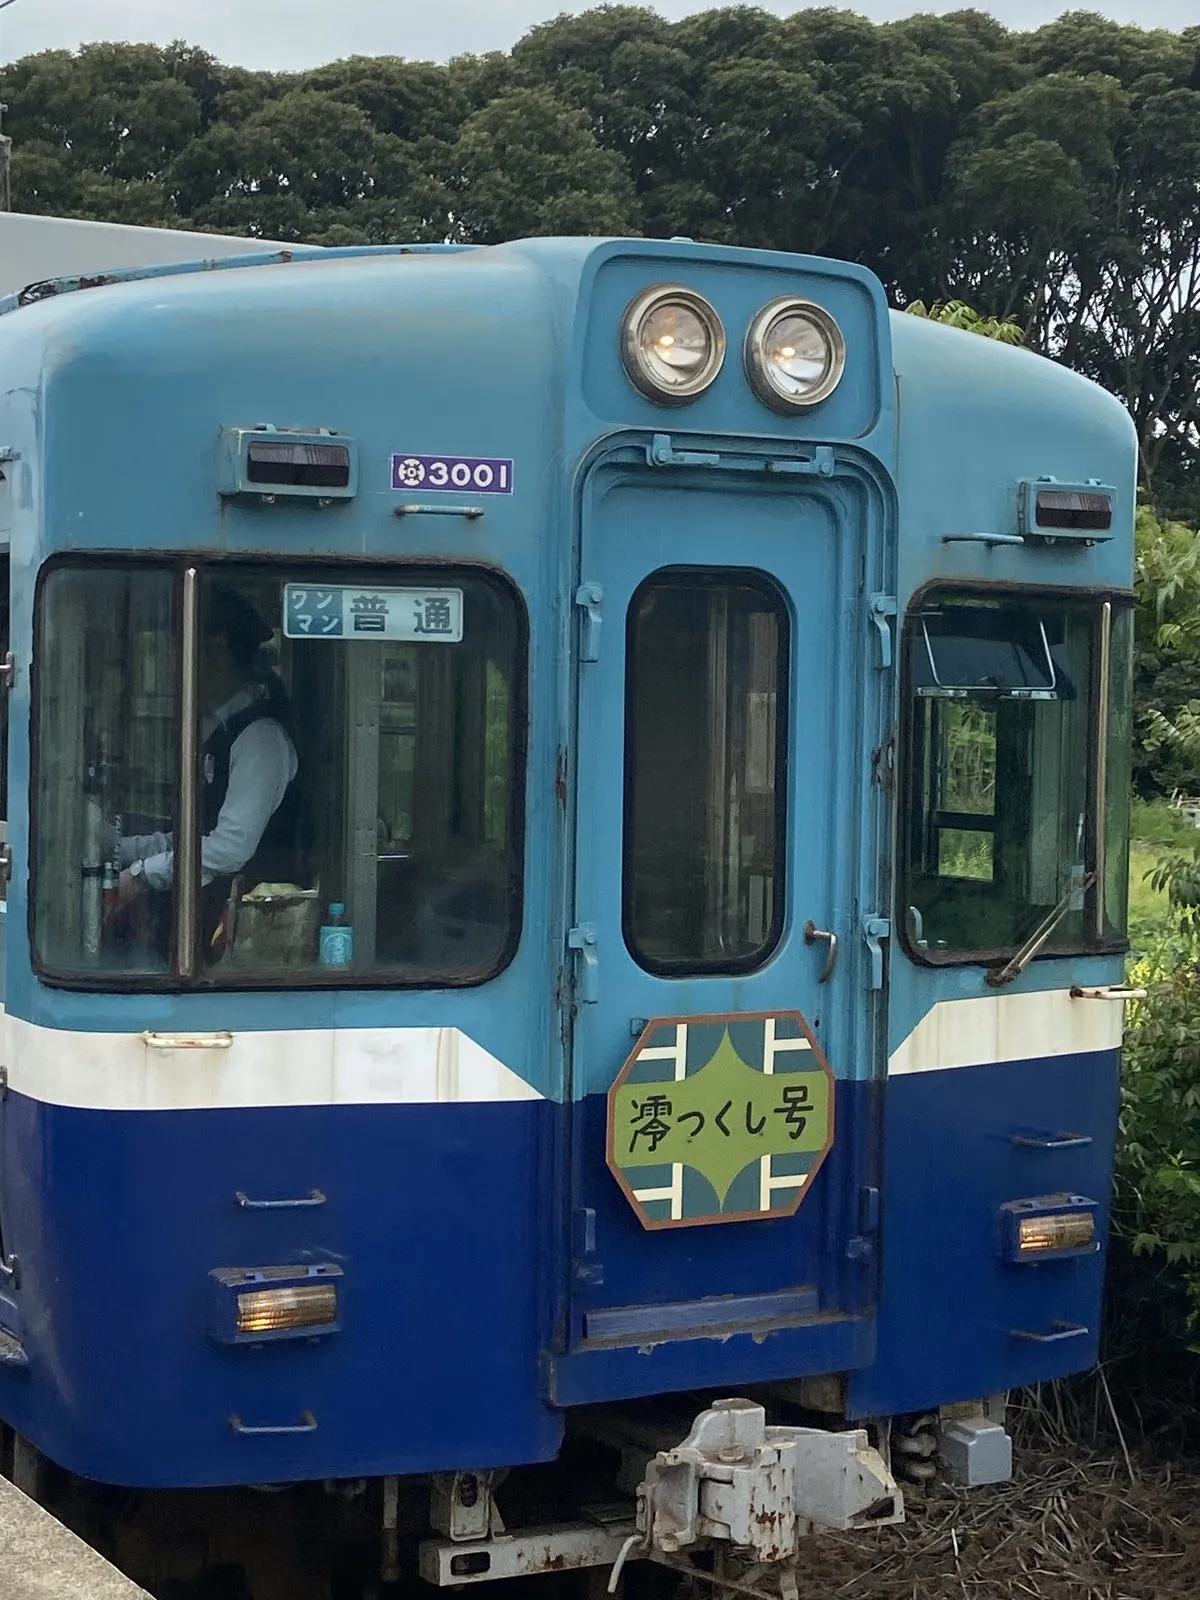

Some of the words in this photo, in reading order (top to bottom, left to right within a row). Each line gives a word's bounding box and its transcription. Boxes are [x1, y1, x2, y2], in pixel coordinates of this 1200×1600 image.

[428, 461, 507, 488] 3001
[291, 590, 333, 610] ワン
[295, 614, 339, 633] マン
[350, 595, 453, 635] 普通
[629, 1085, 814, 1153] 澪つくし号
